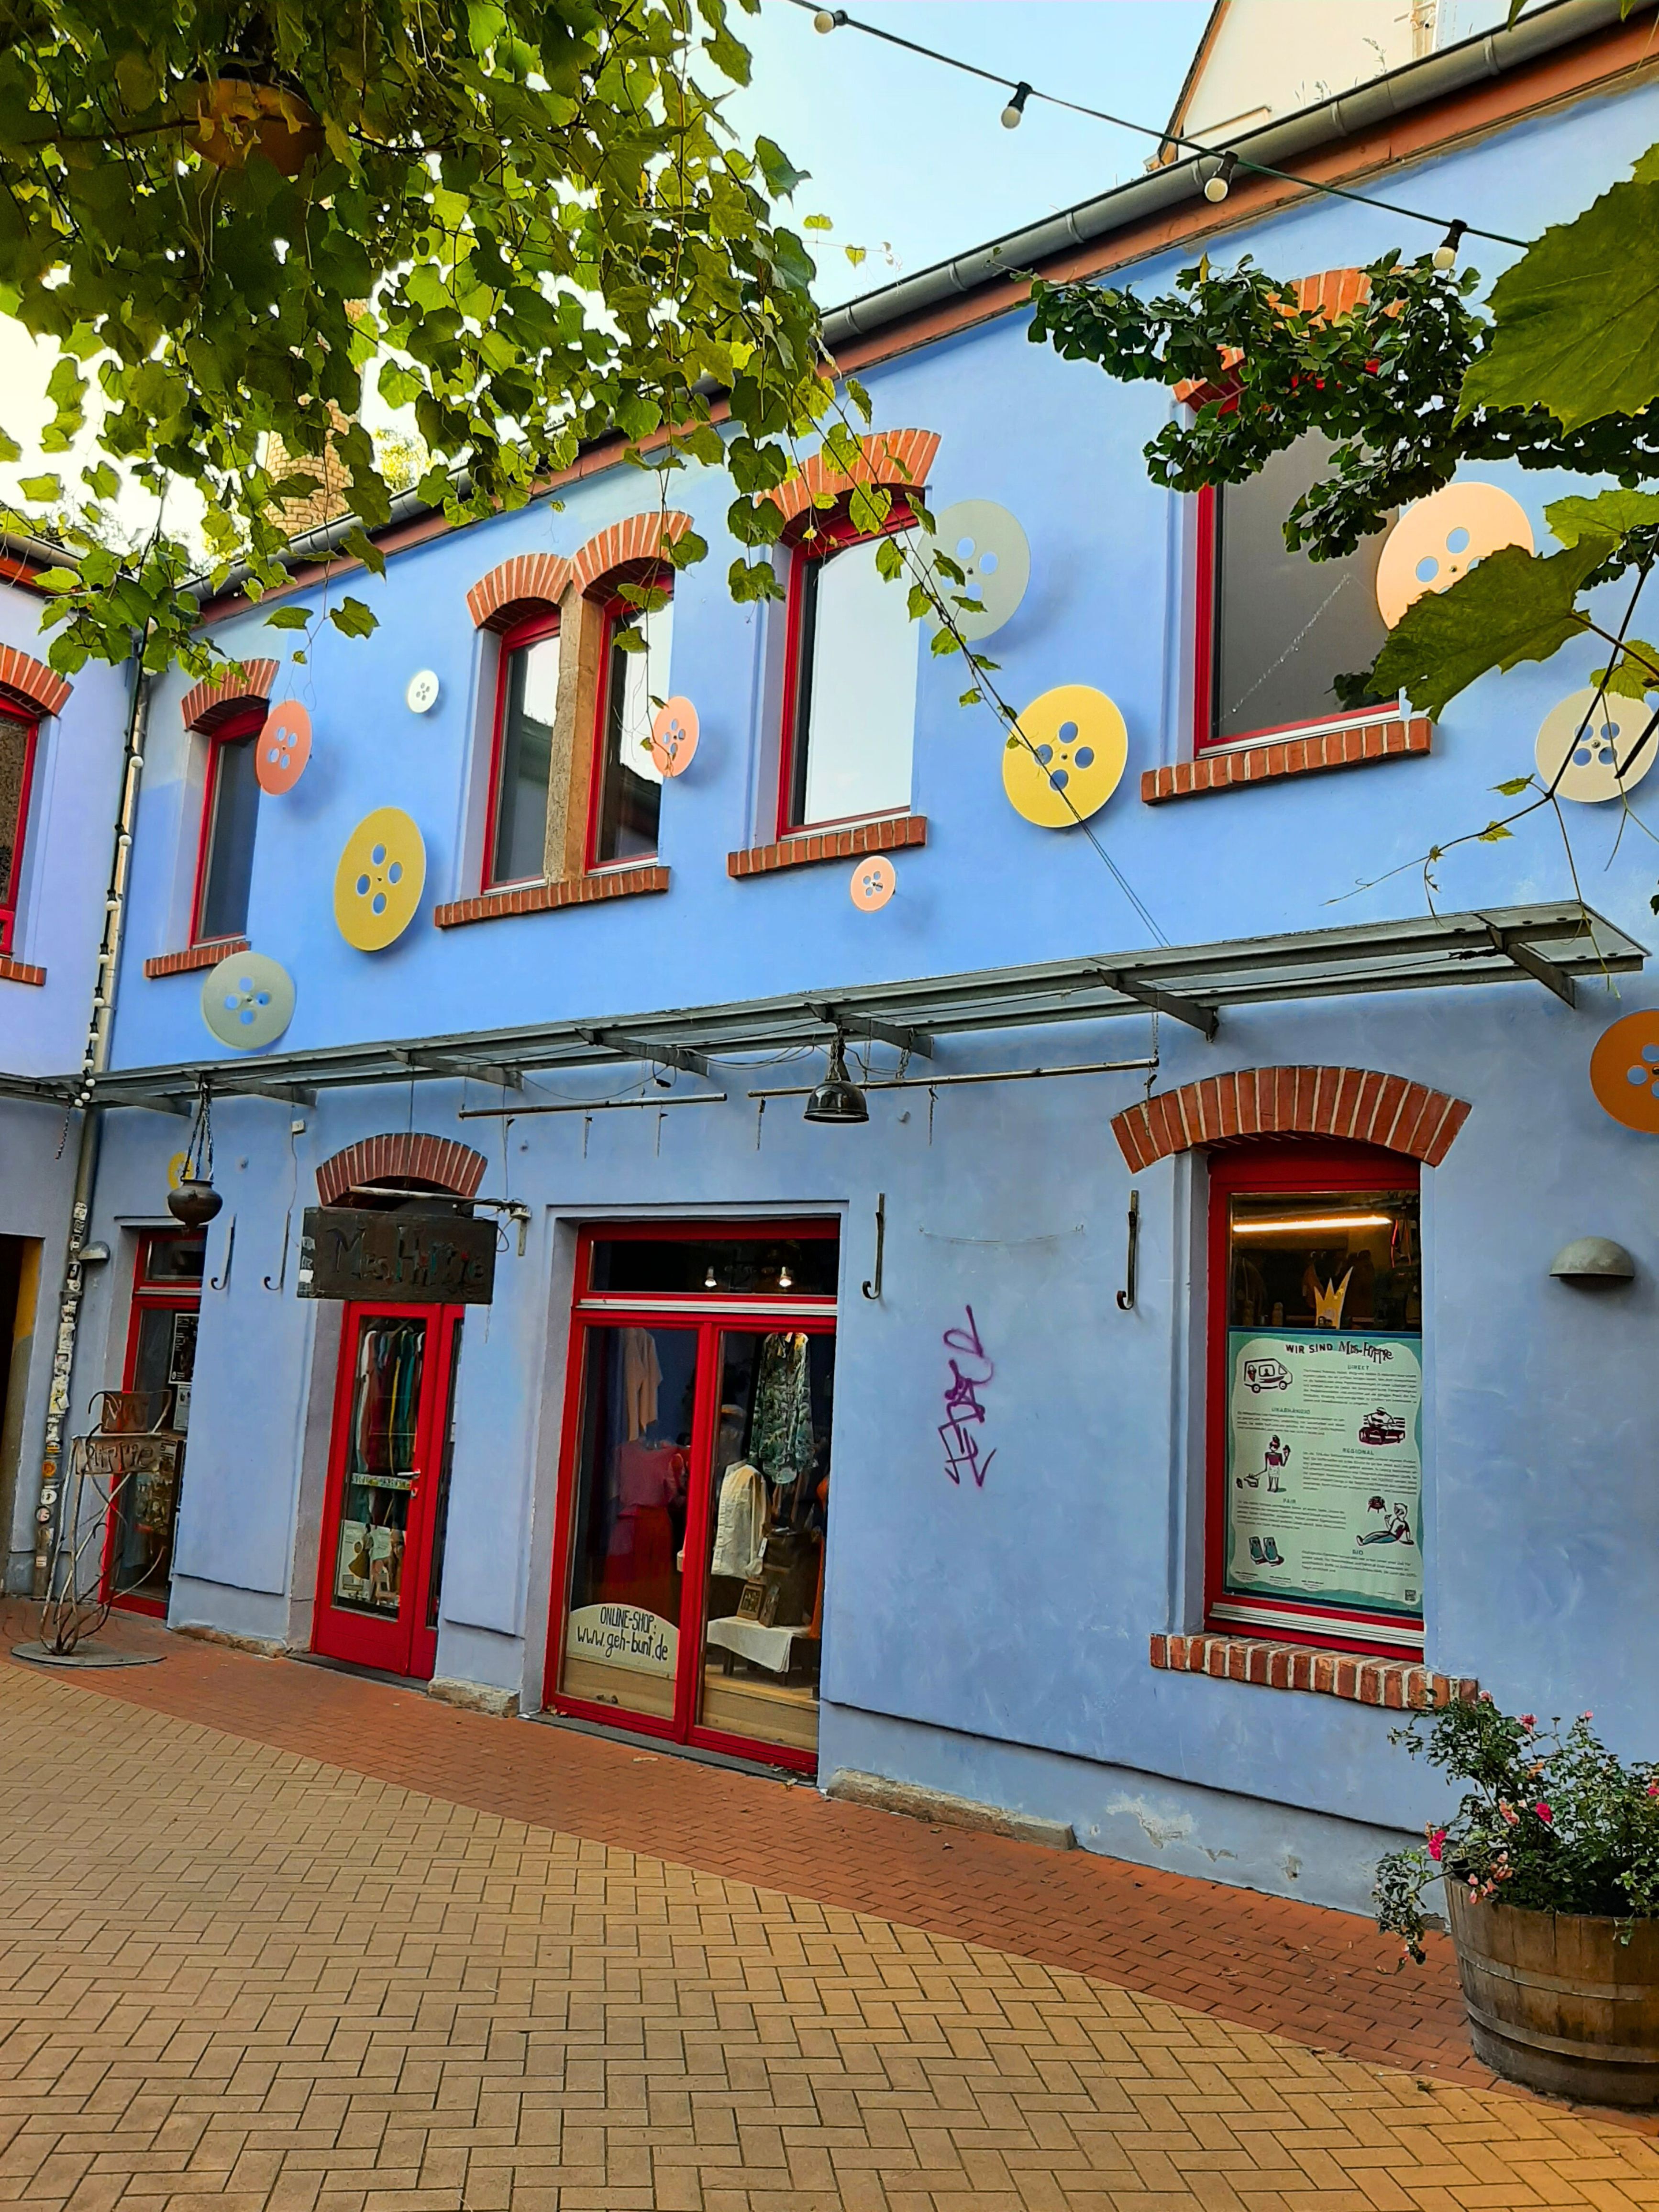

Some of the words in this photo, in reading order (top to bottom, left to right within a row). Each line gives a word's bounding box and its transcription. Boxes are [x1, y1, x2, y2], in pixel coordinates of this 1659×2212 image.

[1285, 1344, 1305, 1354] WIR
[1309, 1343, 1333, 1353] SIND
[577, 1626, 668, 1661] www.geh-bunt.de
